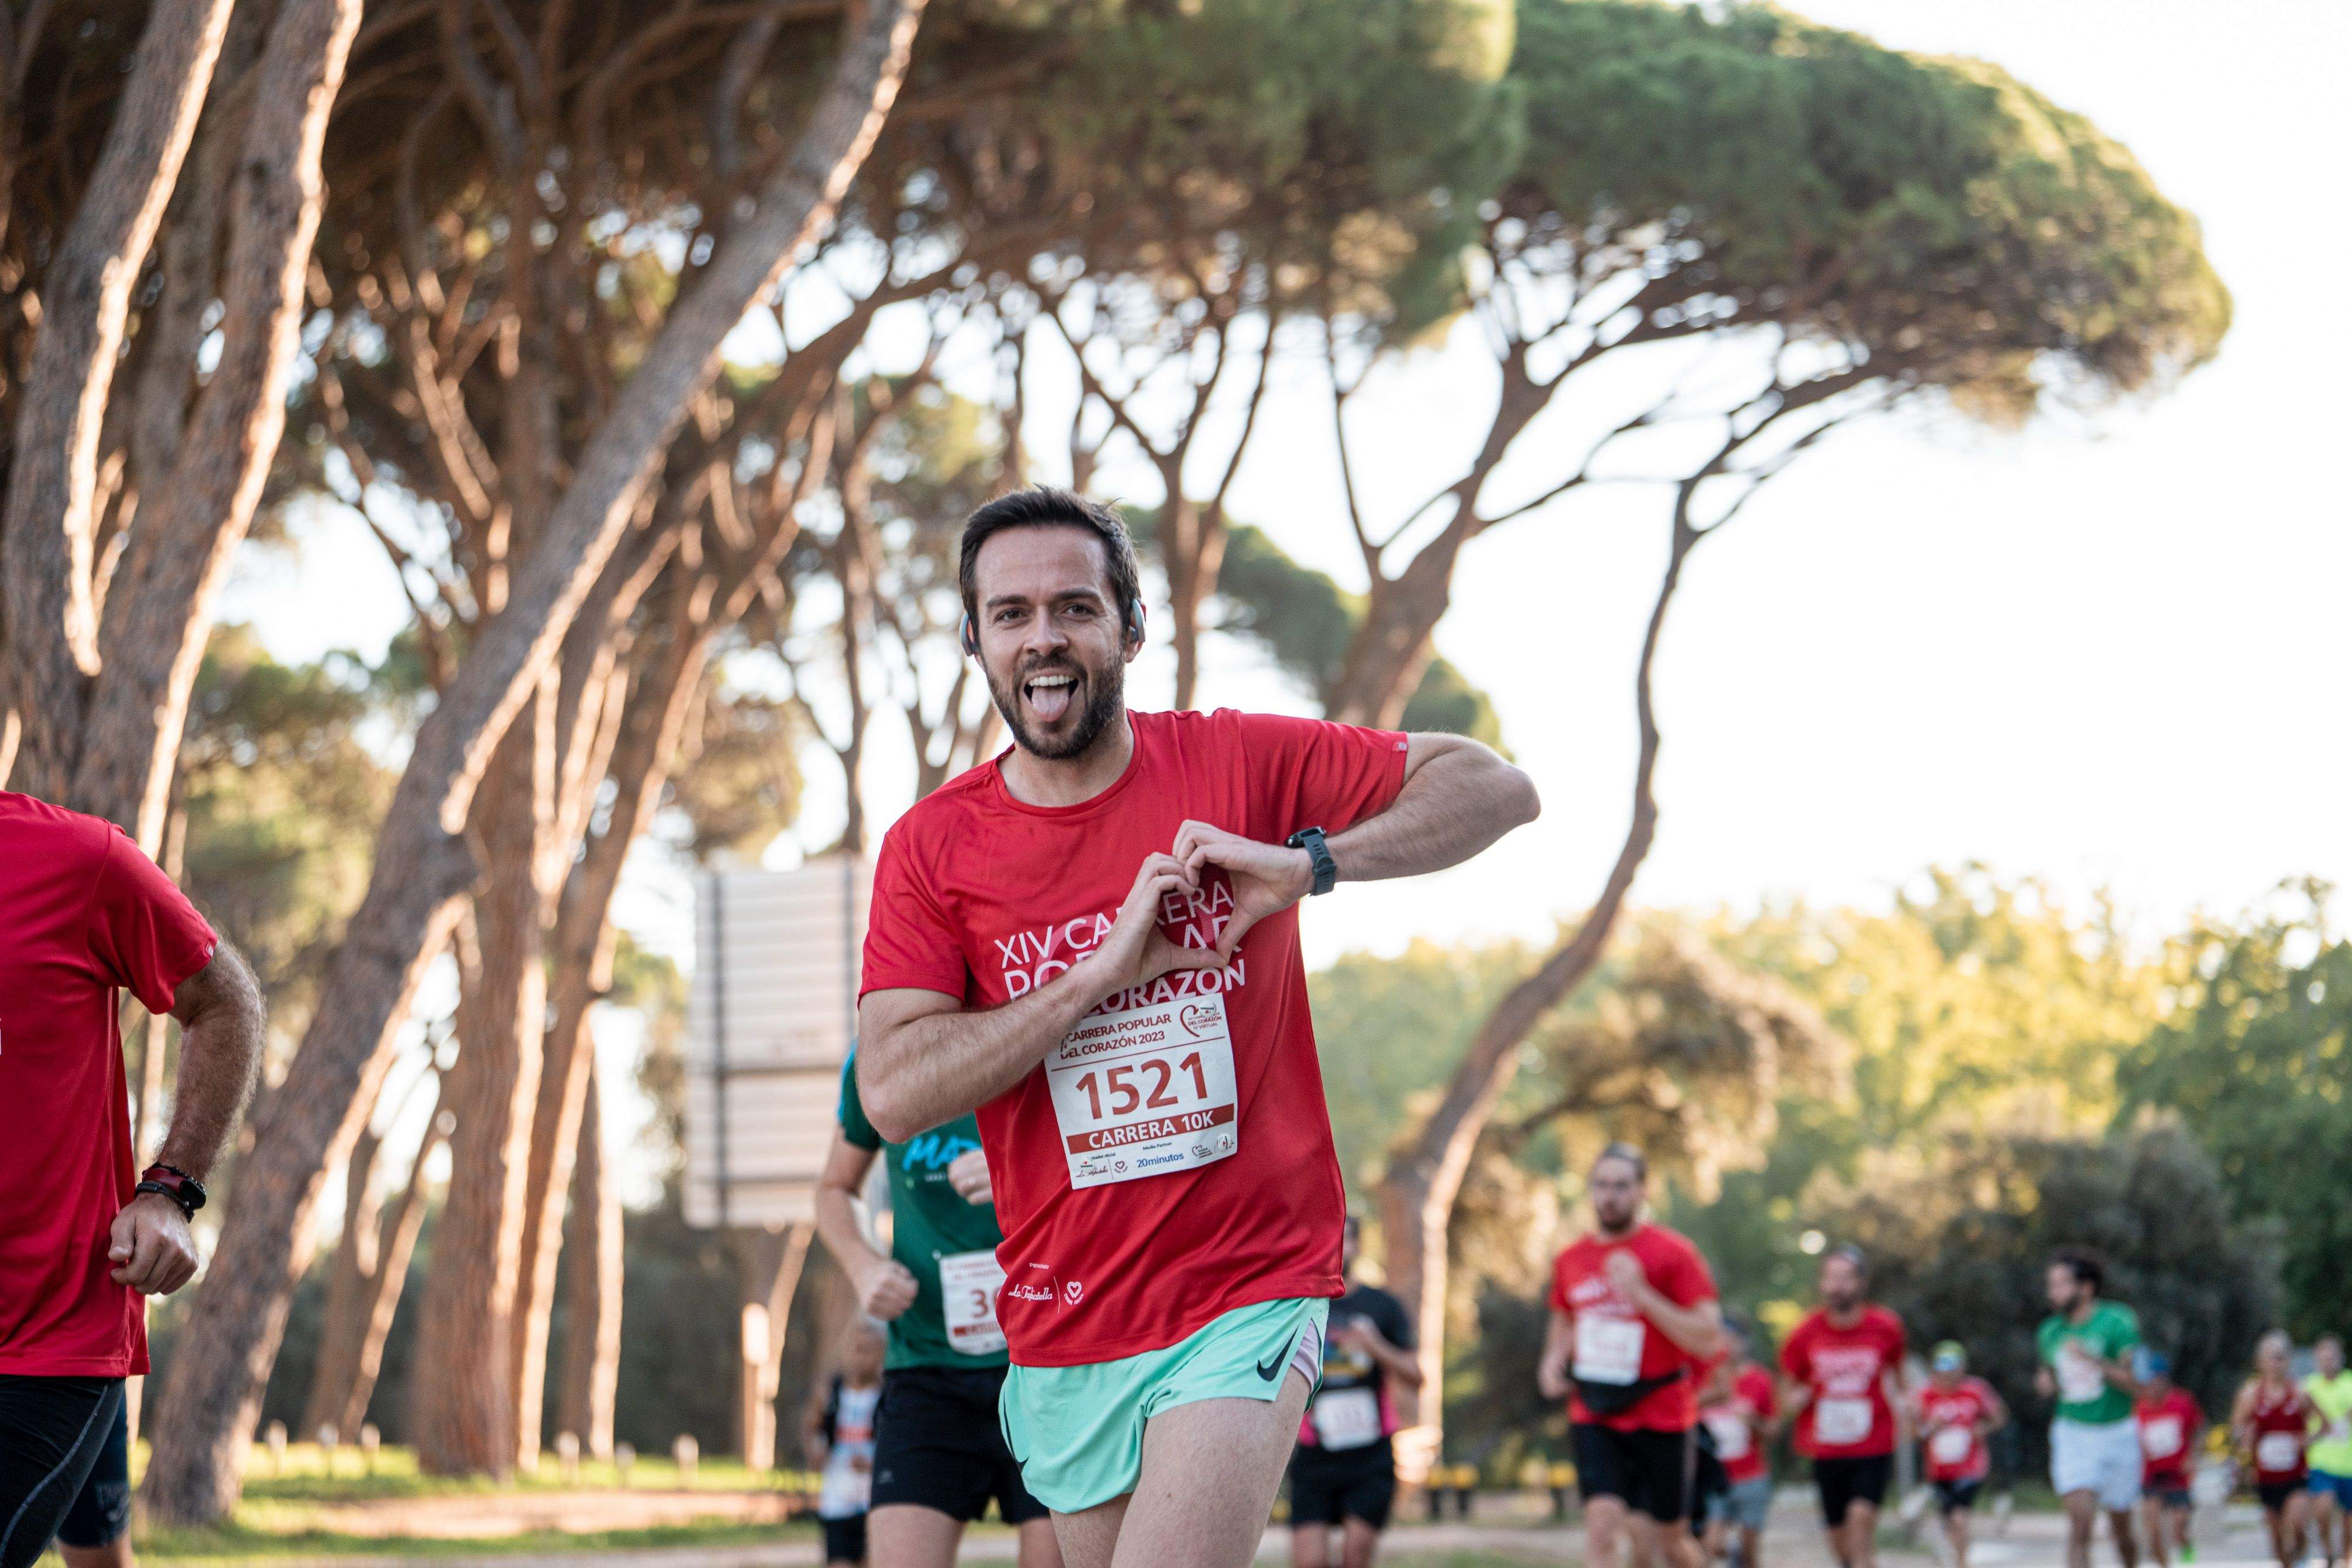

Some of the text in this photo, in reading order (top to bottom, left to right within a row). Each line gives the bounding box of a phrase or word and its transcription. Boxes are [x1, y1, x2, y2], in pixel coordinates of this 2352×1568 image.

[994, 881, 1234, 969] XIV CAERA
[1118, 1014, 1172, 1032] POPULAR
[1082, 1036, 1137, 1055] CORAZÓN
[1138, 1031, 1165, 1044] 2023
[1075, 1051, 1208, 1120] 1521
[1088, 1110, 1215, 1149] CARRERA 10K
[1137, 1153, 1184, 1168] 20minutos
